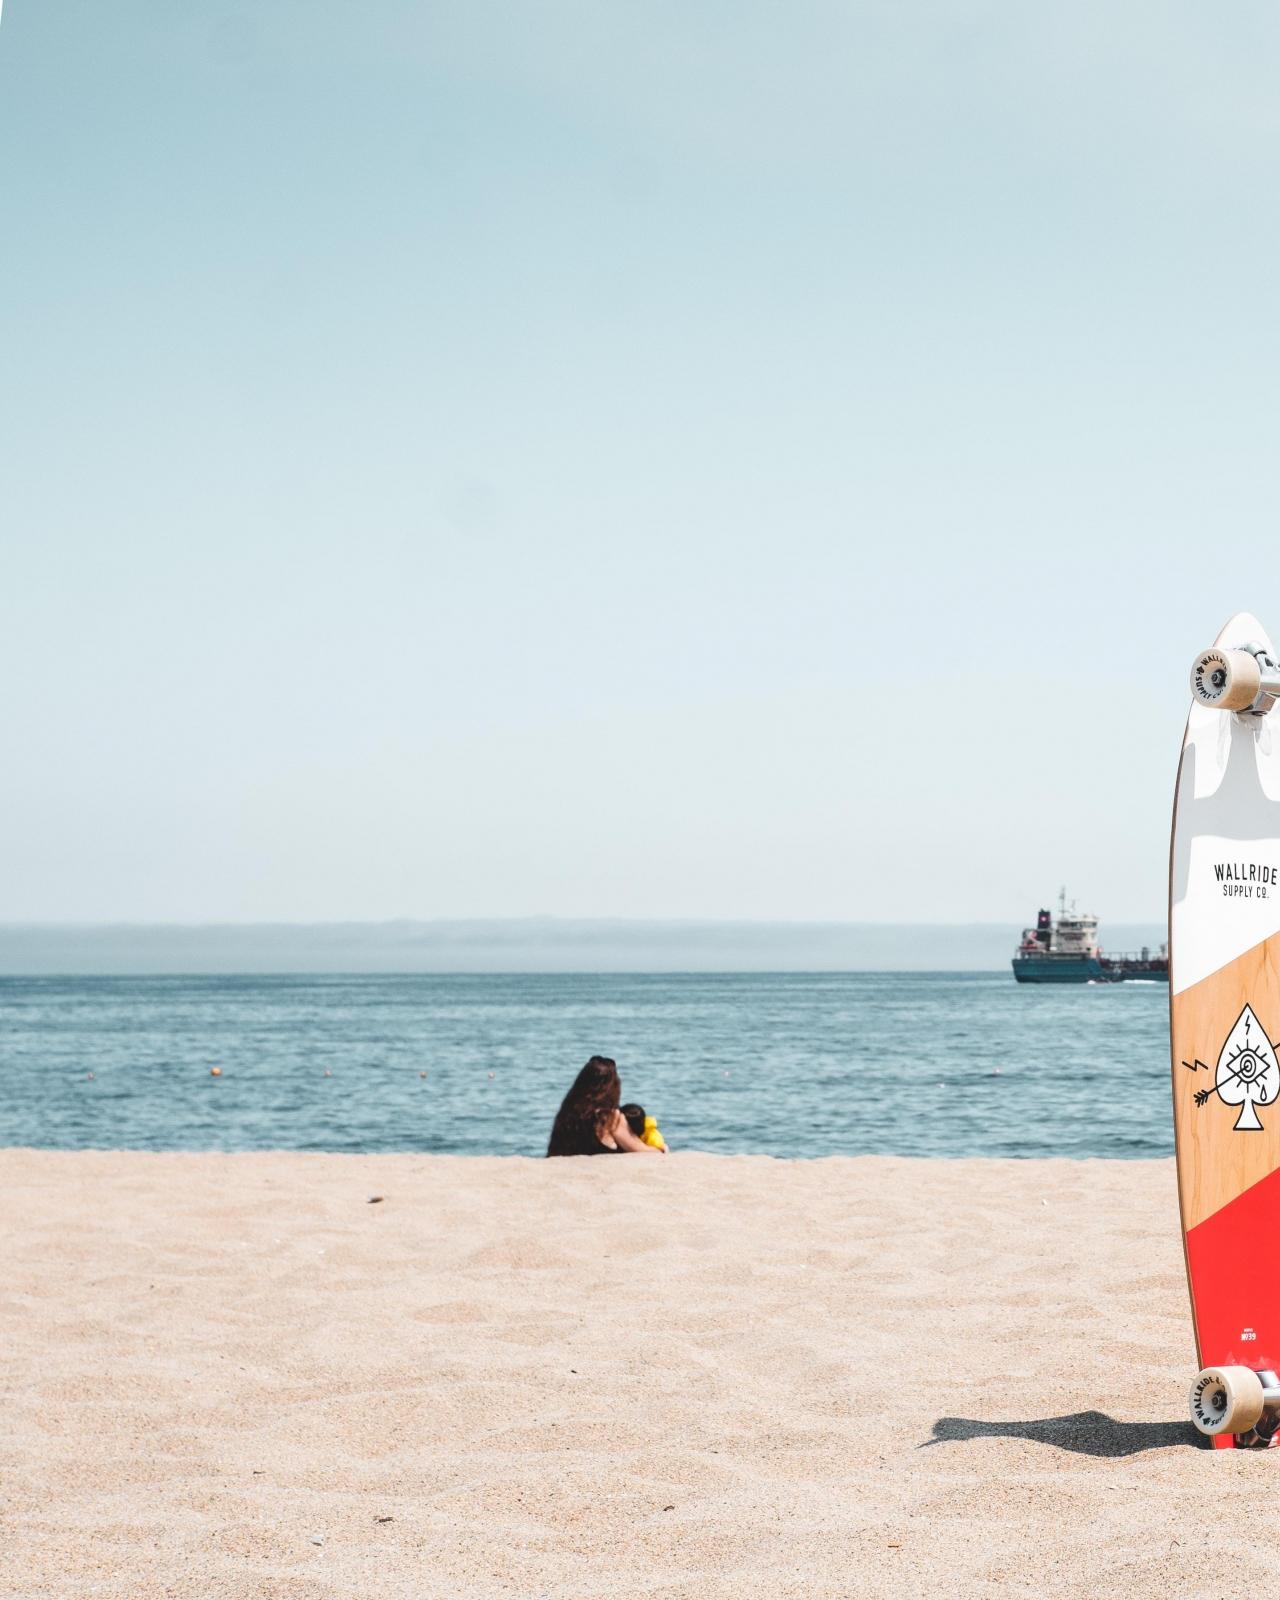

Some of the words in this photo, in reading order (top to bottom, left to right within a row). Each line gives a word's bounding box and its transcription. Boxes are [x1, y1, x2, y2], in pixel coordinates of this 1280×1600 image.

[1195, 676, 1212, 699] SUPPLY
[1214, 862, 1278, 885] WALLRIDE
[1223, 884, 1253, 898] SUPPLY
[1193, 1376, 1214, 1420] WALLRIDE
